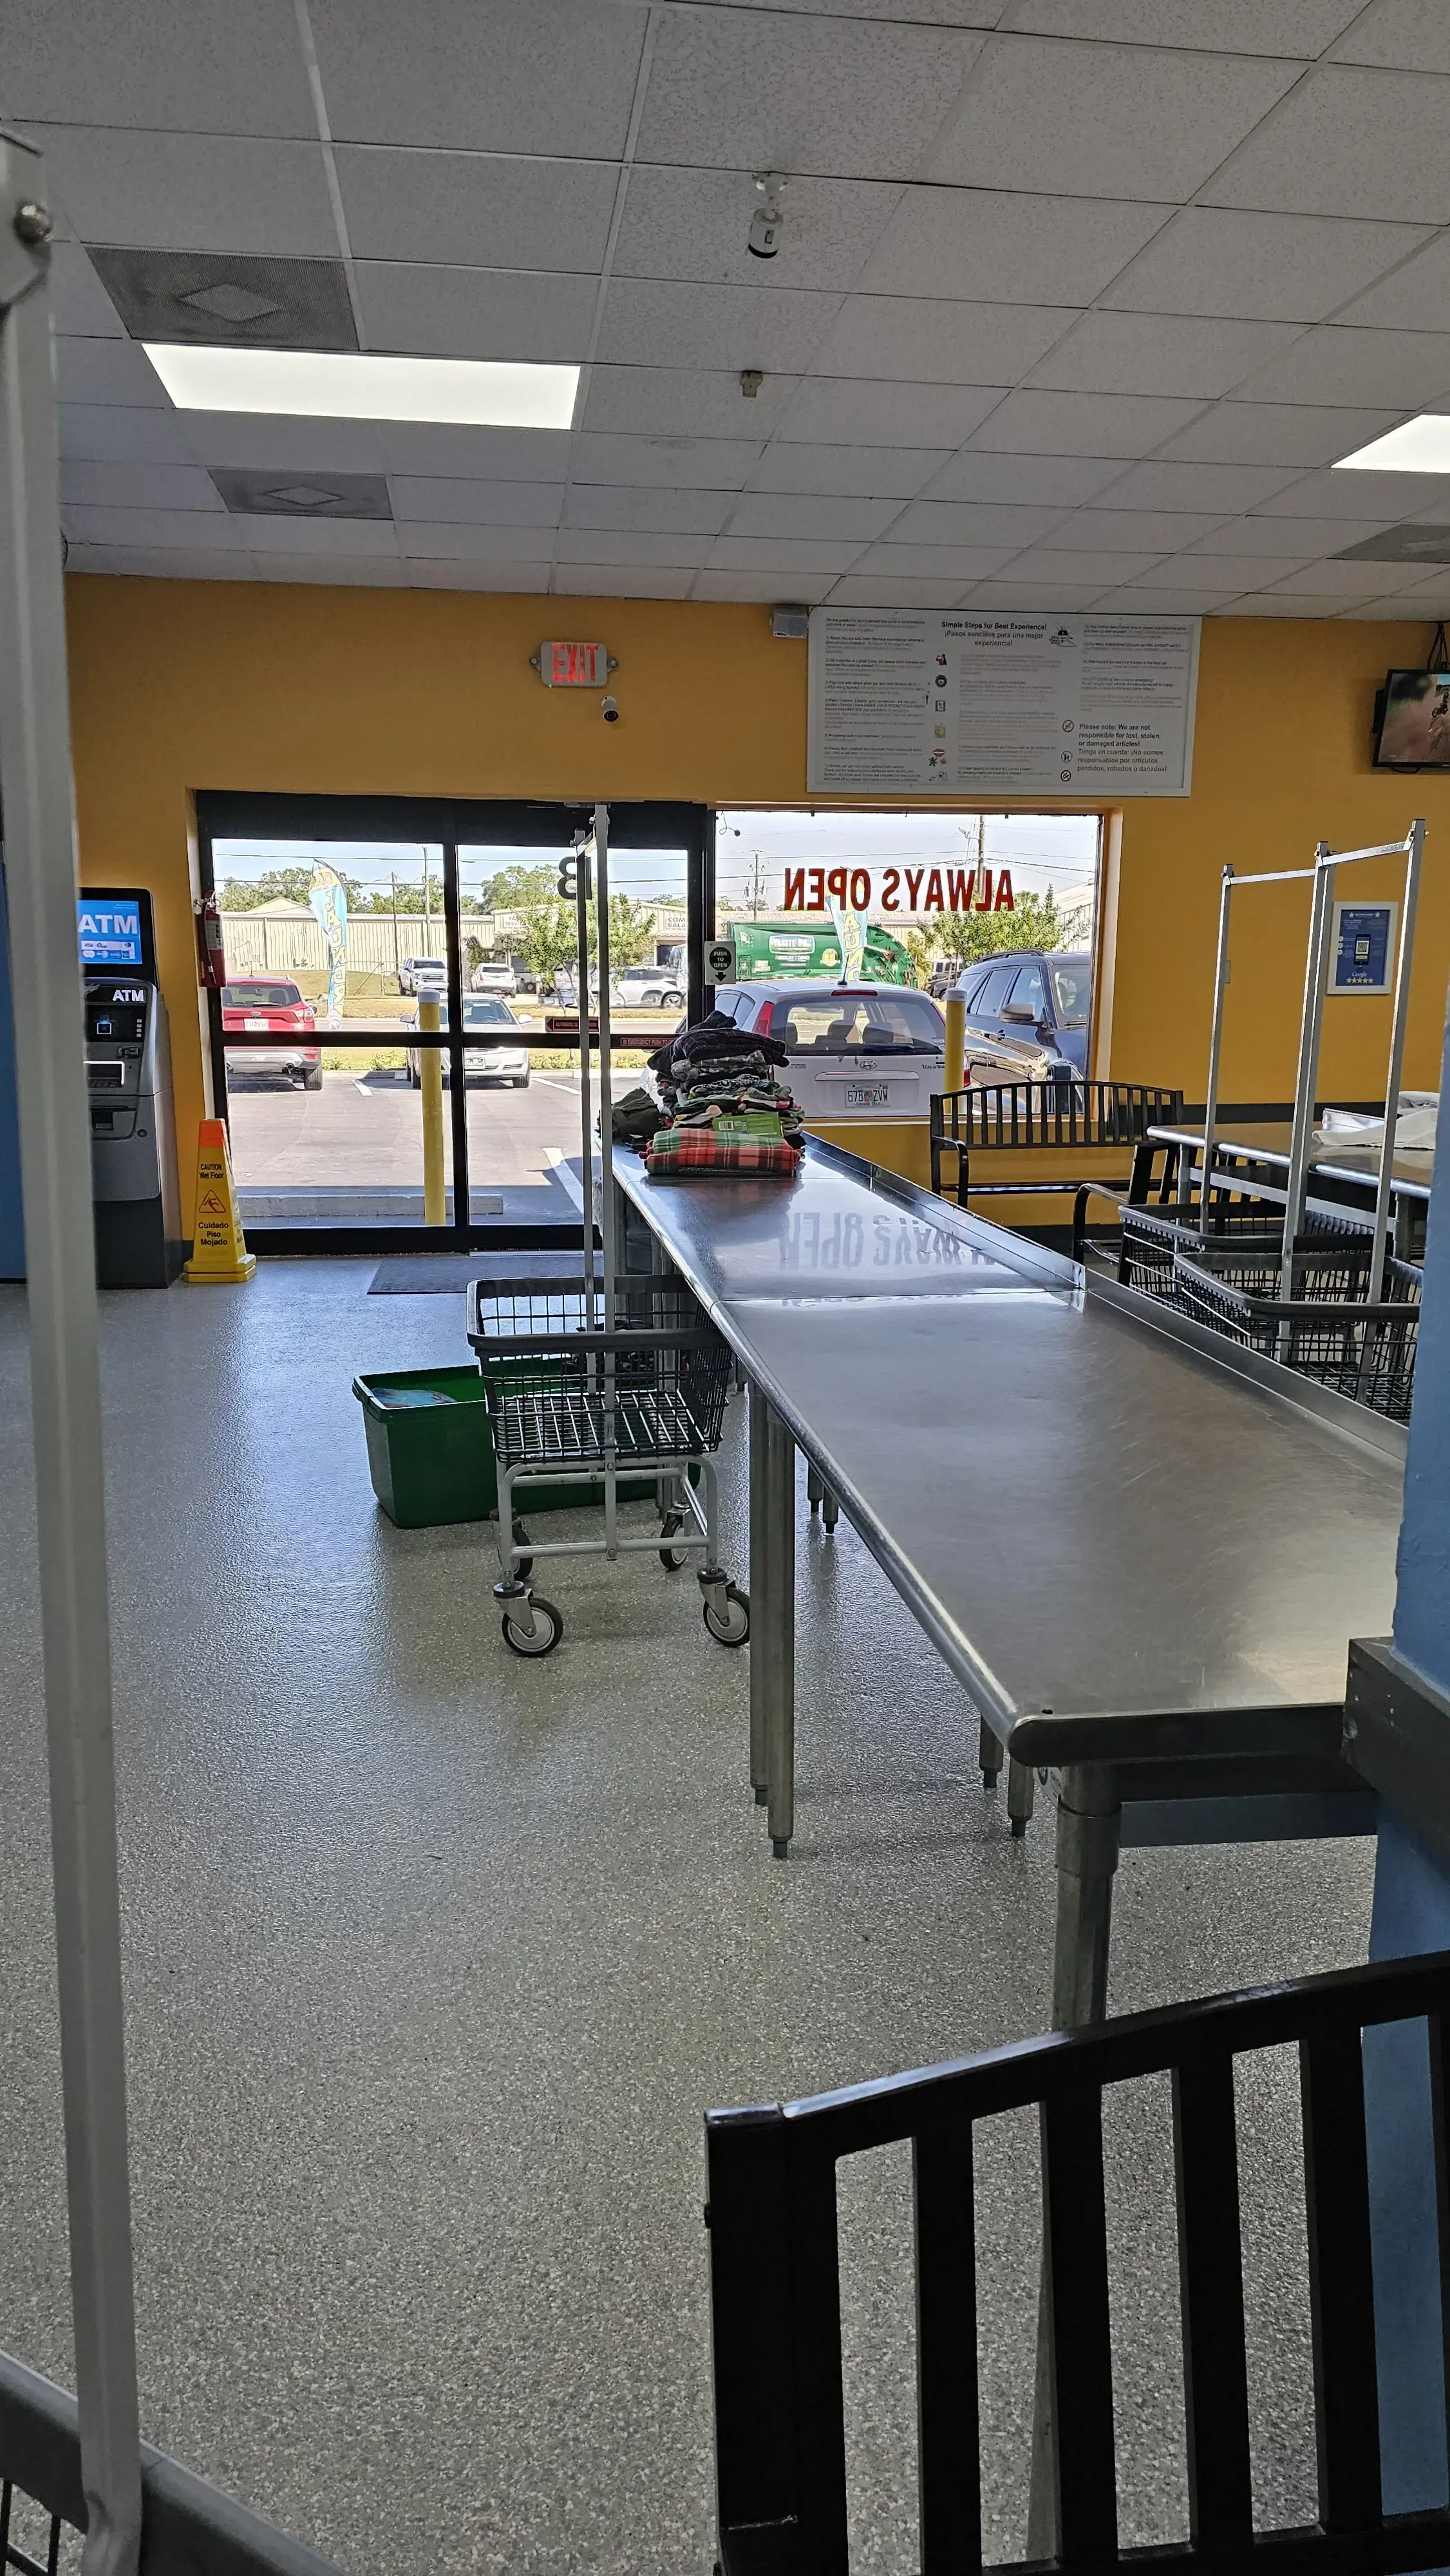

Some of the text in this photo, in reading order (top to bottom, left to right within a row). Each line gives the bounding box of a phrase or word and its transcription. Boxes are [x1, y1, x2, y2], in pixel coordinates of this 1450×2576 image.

[552, 643, 598, 683] EXIT
[77, 914, 138, 934] ATM
[112, 989, 144, 1002] ATM
[873, 1089, 889, 1102] ZVW
[200, 1238, 228, 1247] Mojado
